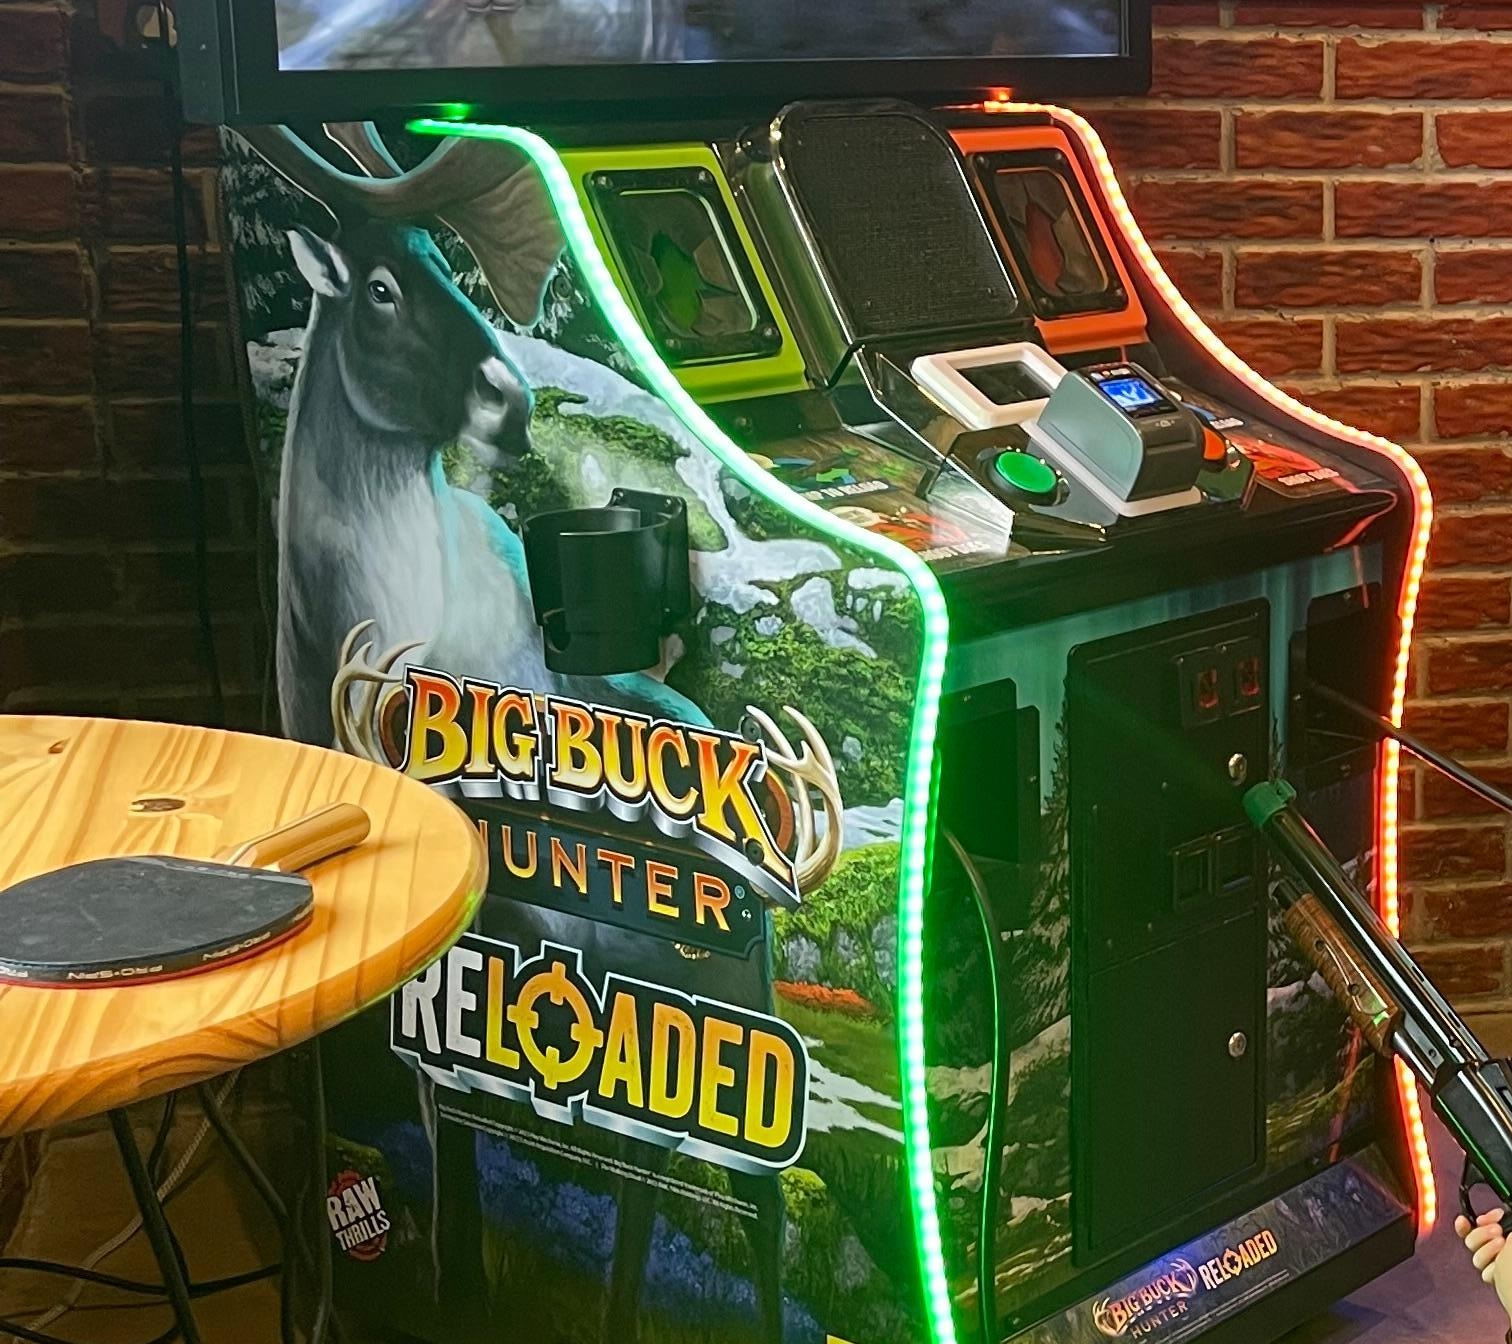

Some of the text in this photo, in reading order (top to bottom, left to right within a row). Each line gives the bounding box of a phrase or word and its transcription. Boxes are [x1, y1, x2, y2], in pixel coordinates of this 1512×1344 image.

[407, 673, 795, 887] BIG BUCK
[478, 819, 732, 932] UNTER
[402, 946, 796, 1149] RELOADED
[327, 1177, 381, 1231] RAW
[336, 1209, 391, 1251] THRILLS
[1198, 1229, 1278, 1290] RELOADED
[1110, 1271, 1187, 1324] BIG BUCK
[1131, 1301, 1188, 1339] HUNTER
